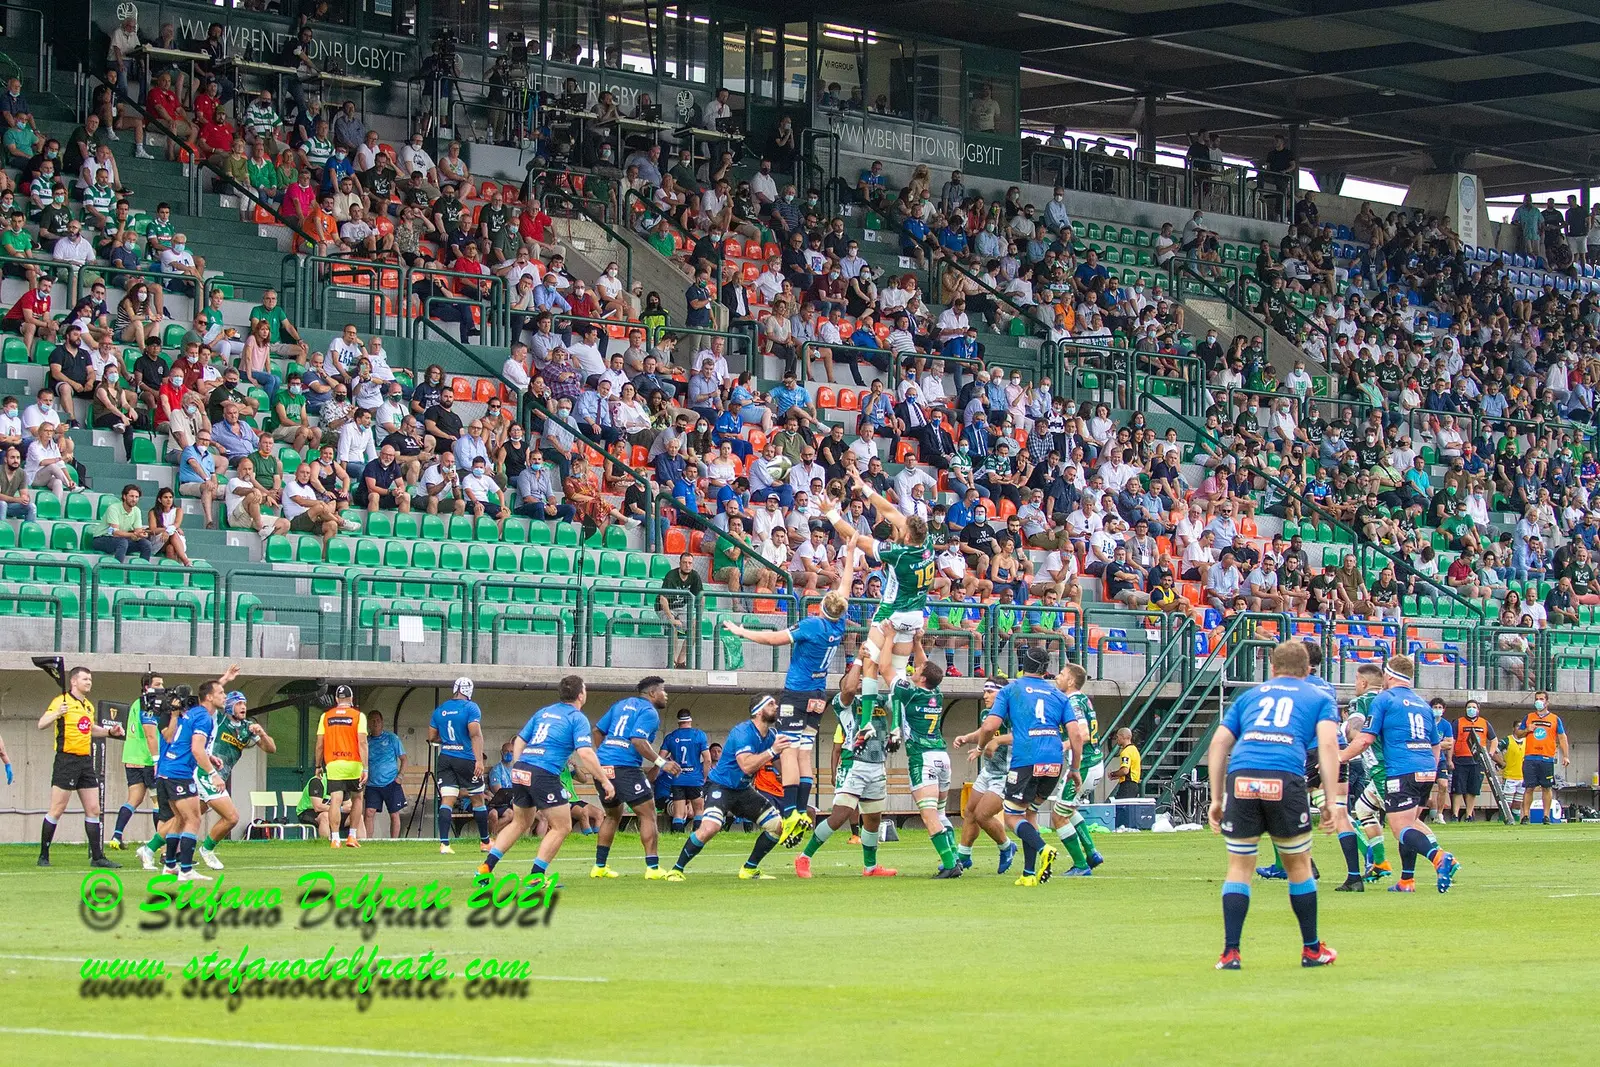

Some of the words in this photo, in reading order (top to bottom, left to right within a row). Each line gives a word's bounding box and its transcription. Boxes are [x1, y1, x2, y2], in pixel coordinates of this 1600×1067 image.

[832, 122, 1003, 166] WWW.BENETTONRUGBY.IT
[914, 561, 935, 589] 19
[286, 632, 296, 651] A
[1035, 698, 1047, 724] 4
[1254, 696, 1294, 728] 20
[447, 719, 456, 741] 6
[924, 714, 939, 735] 7
[680, 745, 688, 764] 2
